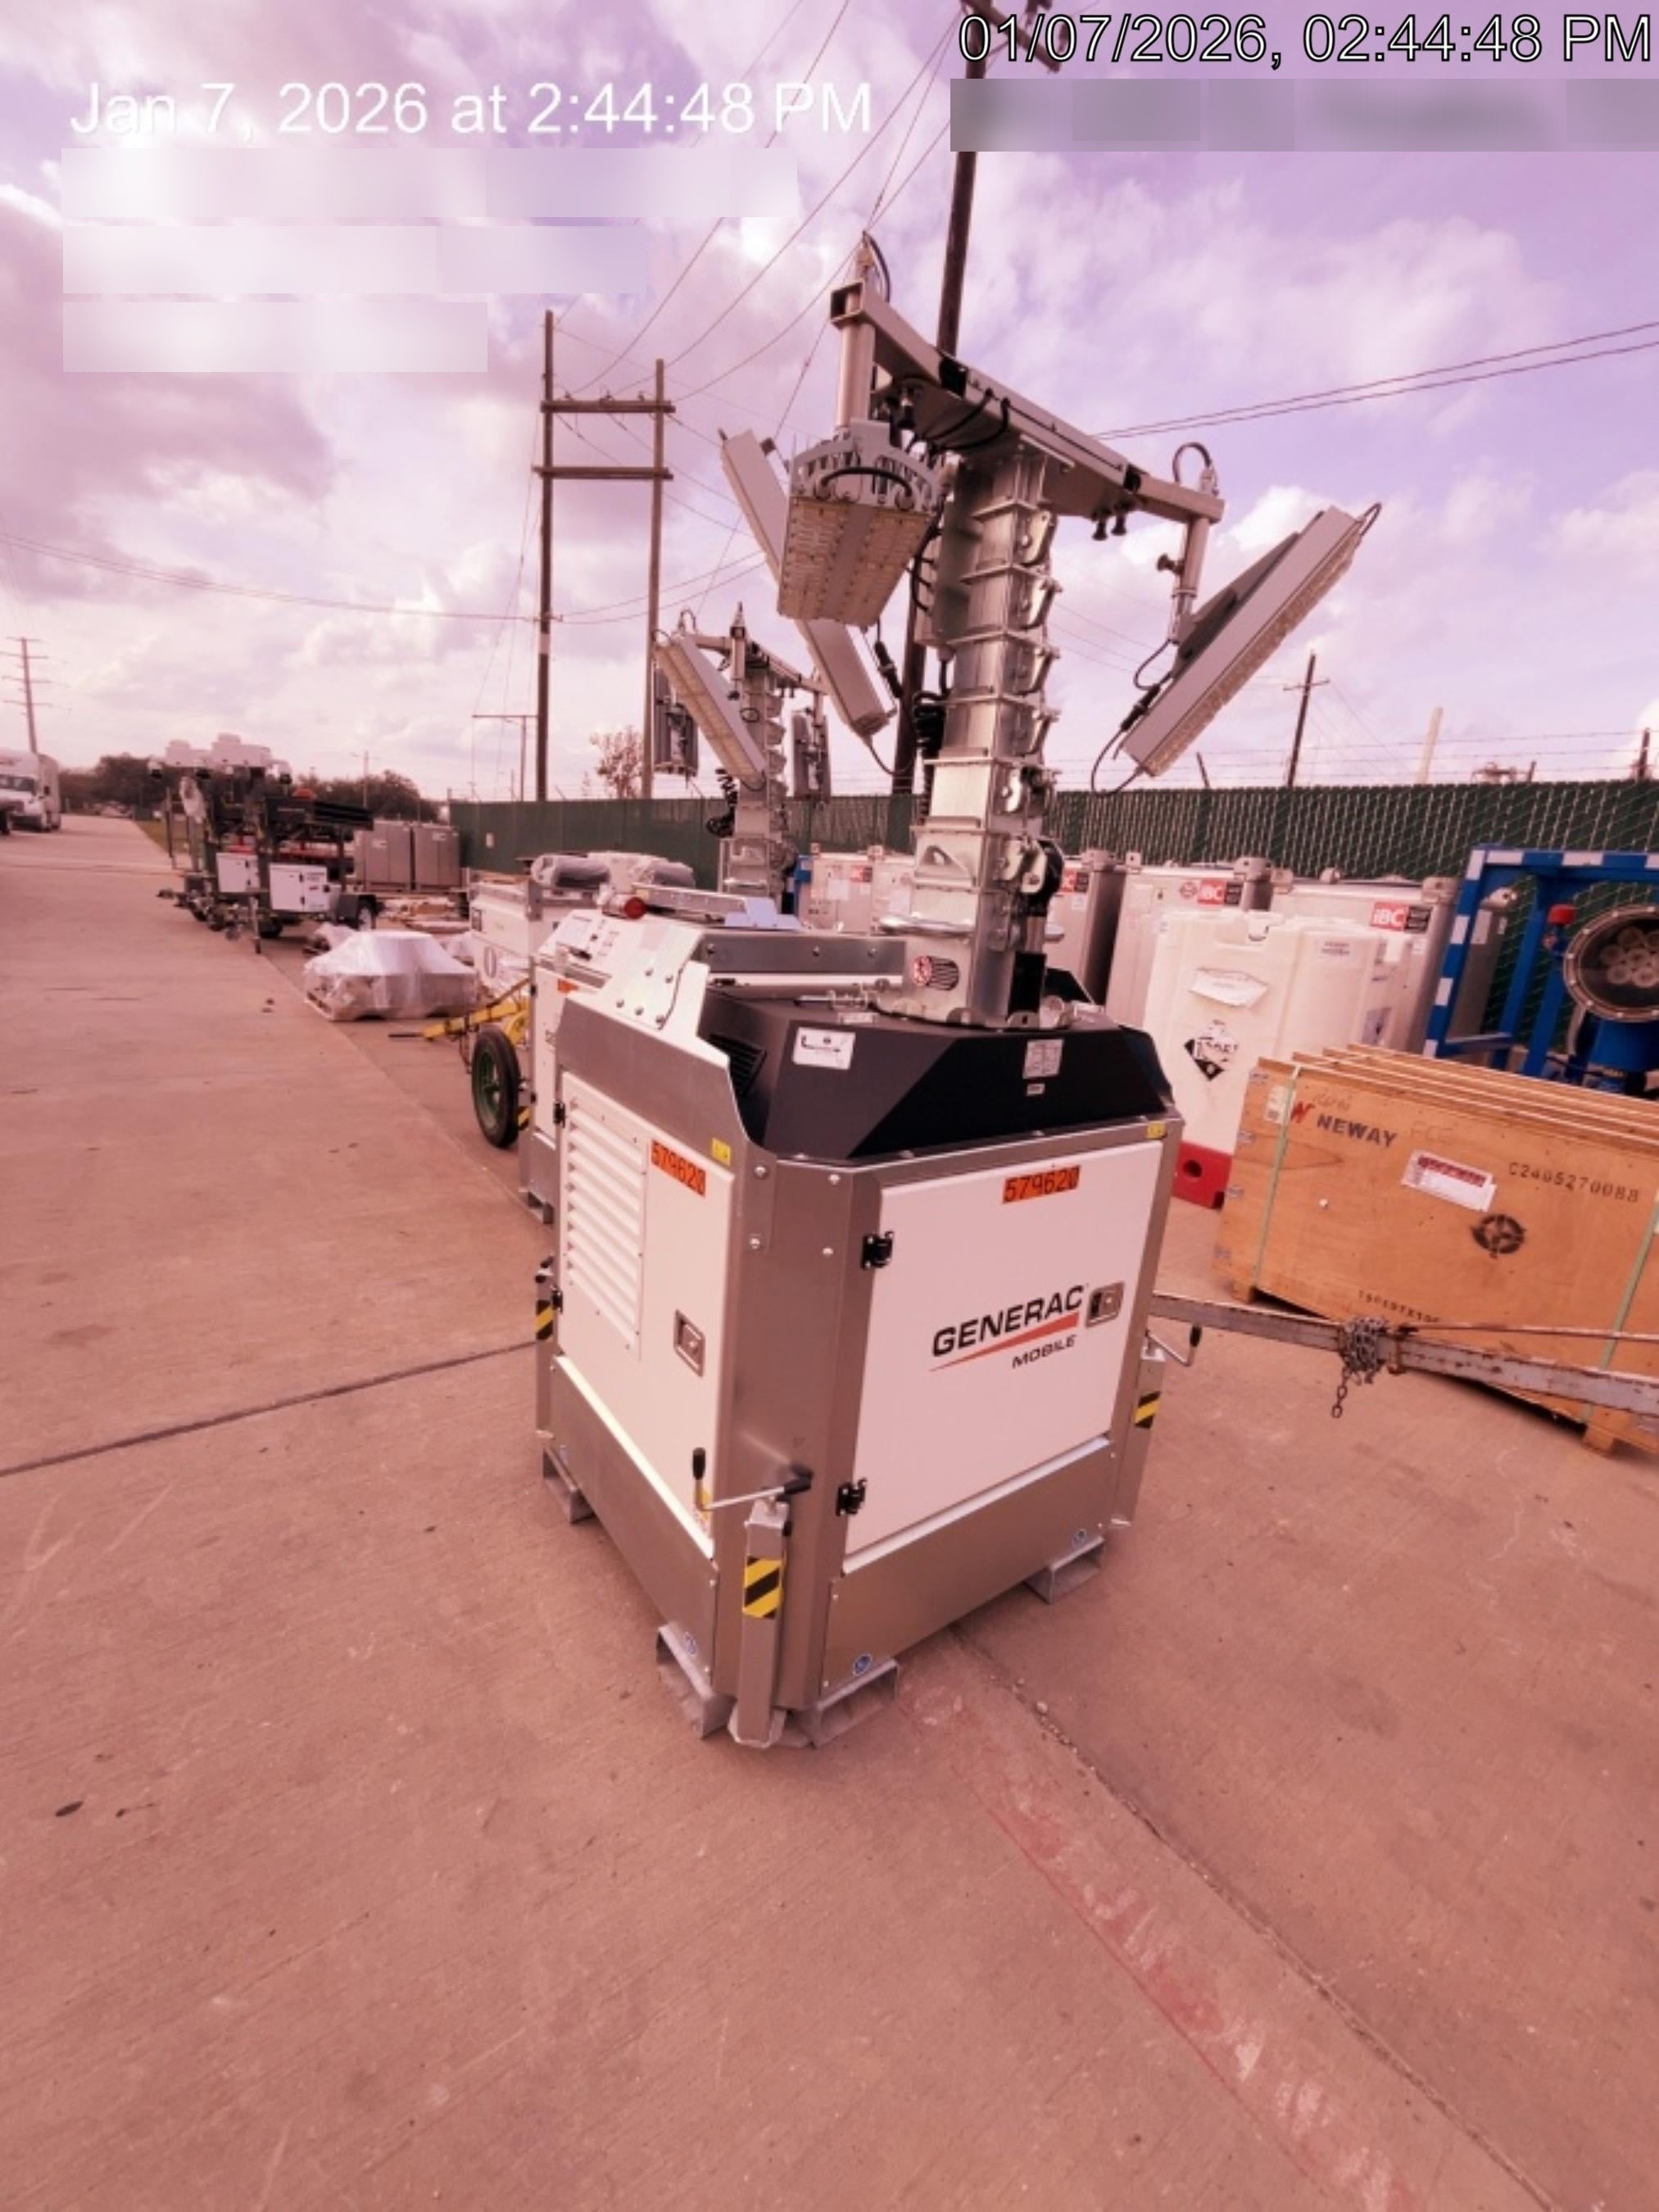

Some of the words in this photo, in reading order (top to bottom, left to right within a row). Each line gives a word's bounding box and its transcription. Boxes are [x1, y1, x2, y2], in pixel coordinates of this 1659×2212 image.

[1317, 1114, 1398, 1148] NEWAY
[651, 1140, 706, 1197] 579620
[1002, 1166, 1081, 1203] 579620
[931, 1285, 1085, 1358] GENERAC
[1011, 1334, 1077, 1369] MOBILE
